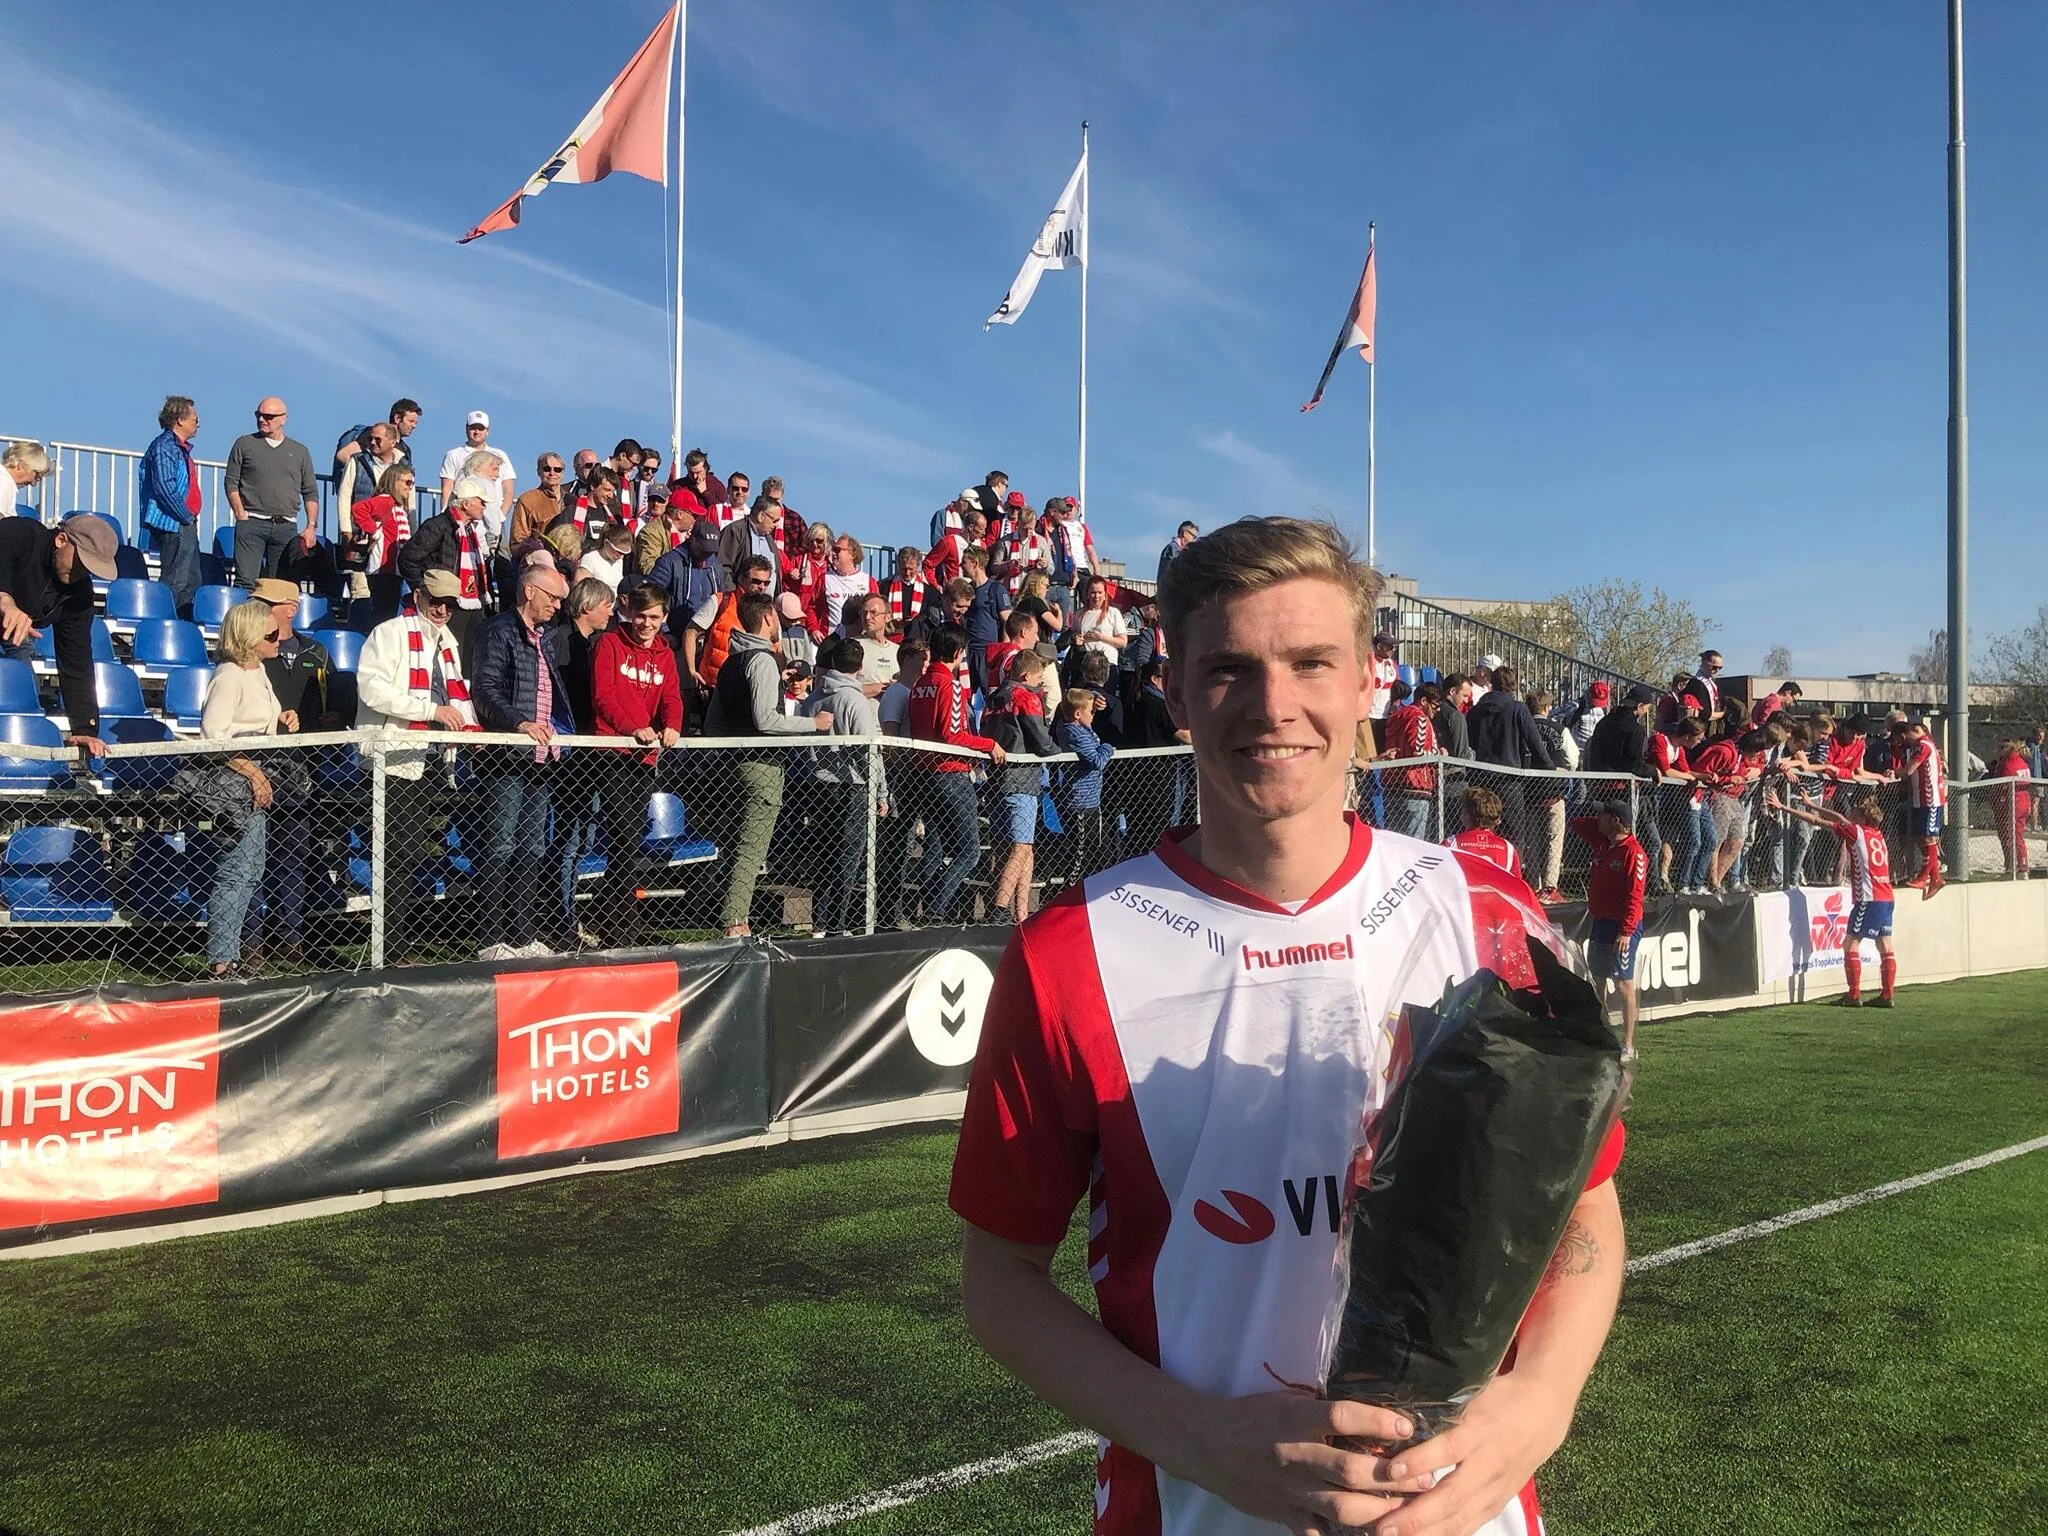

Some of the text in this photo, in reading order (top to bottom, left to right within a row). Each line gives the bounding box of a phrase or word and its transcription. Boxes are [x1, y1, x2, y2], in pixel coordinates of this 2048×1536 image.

[911, 685, 938, 699] LYN
[1110, 886, 1200, 939] SISSENER
[1362, 868, 1423, 935] SISSENER
[1242, 933, 1355, 971] hummel
[508, 1010, 672, 1070] THON
[0, 1057, 206, 1127] THON
[530, 1065, 651, 1105] HOTELS
[0, 1121, 177, 1169] HOTELS
[1282, 1175, 1342, 1236] VI
